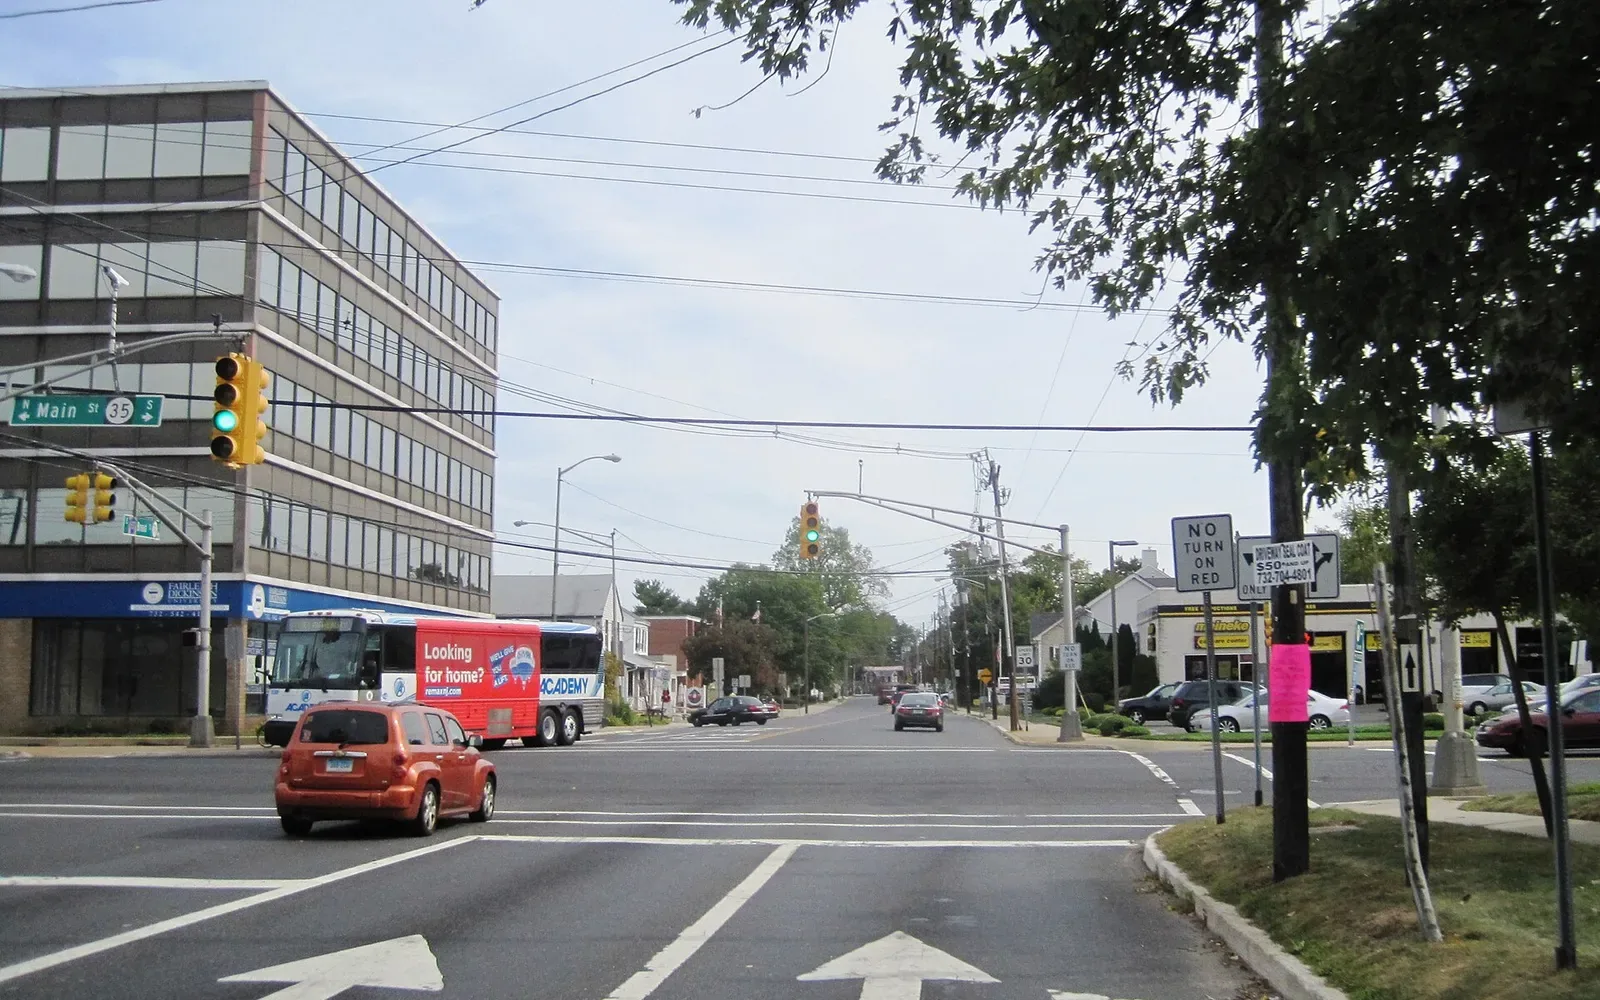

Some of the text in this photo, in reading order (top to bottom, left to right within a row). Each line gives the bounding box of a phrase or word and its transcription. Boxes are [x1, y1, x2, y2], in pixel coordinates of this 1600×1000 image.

[22, 399, 153, 418] N Main St 35 S
[1188, 522, 1216, 537] NO
[1184, 540, 1223, 553] TURN
[1255, 546, 1281, 560] DRIVEWAY
[1194, 556, 1215, 568] ON
[1191, 572, 1220, 584] RED
[1242, 584, 1267, 595] ONLY
[424, 643, 472, 663] Looking
[1018, 656, 1032, 665] 30
[425, 666, 485, 683] for home?
[425, 687, 462, 696] remaxnj.com
[539, 677, 589, 695] ACADEMY
